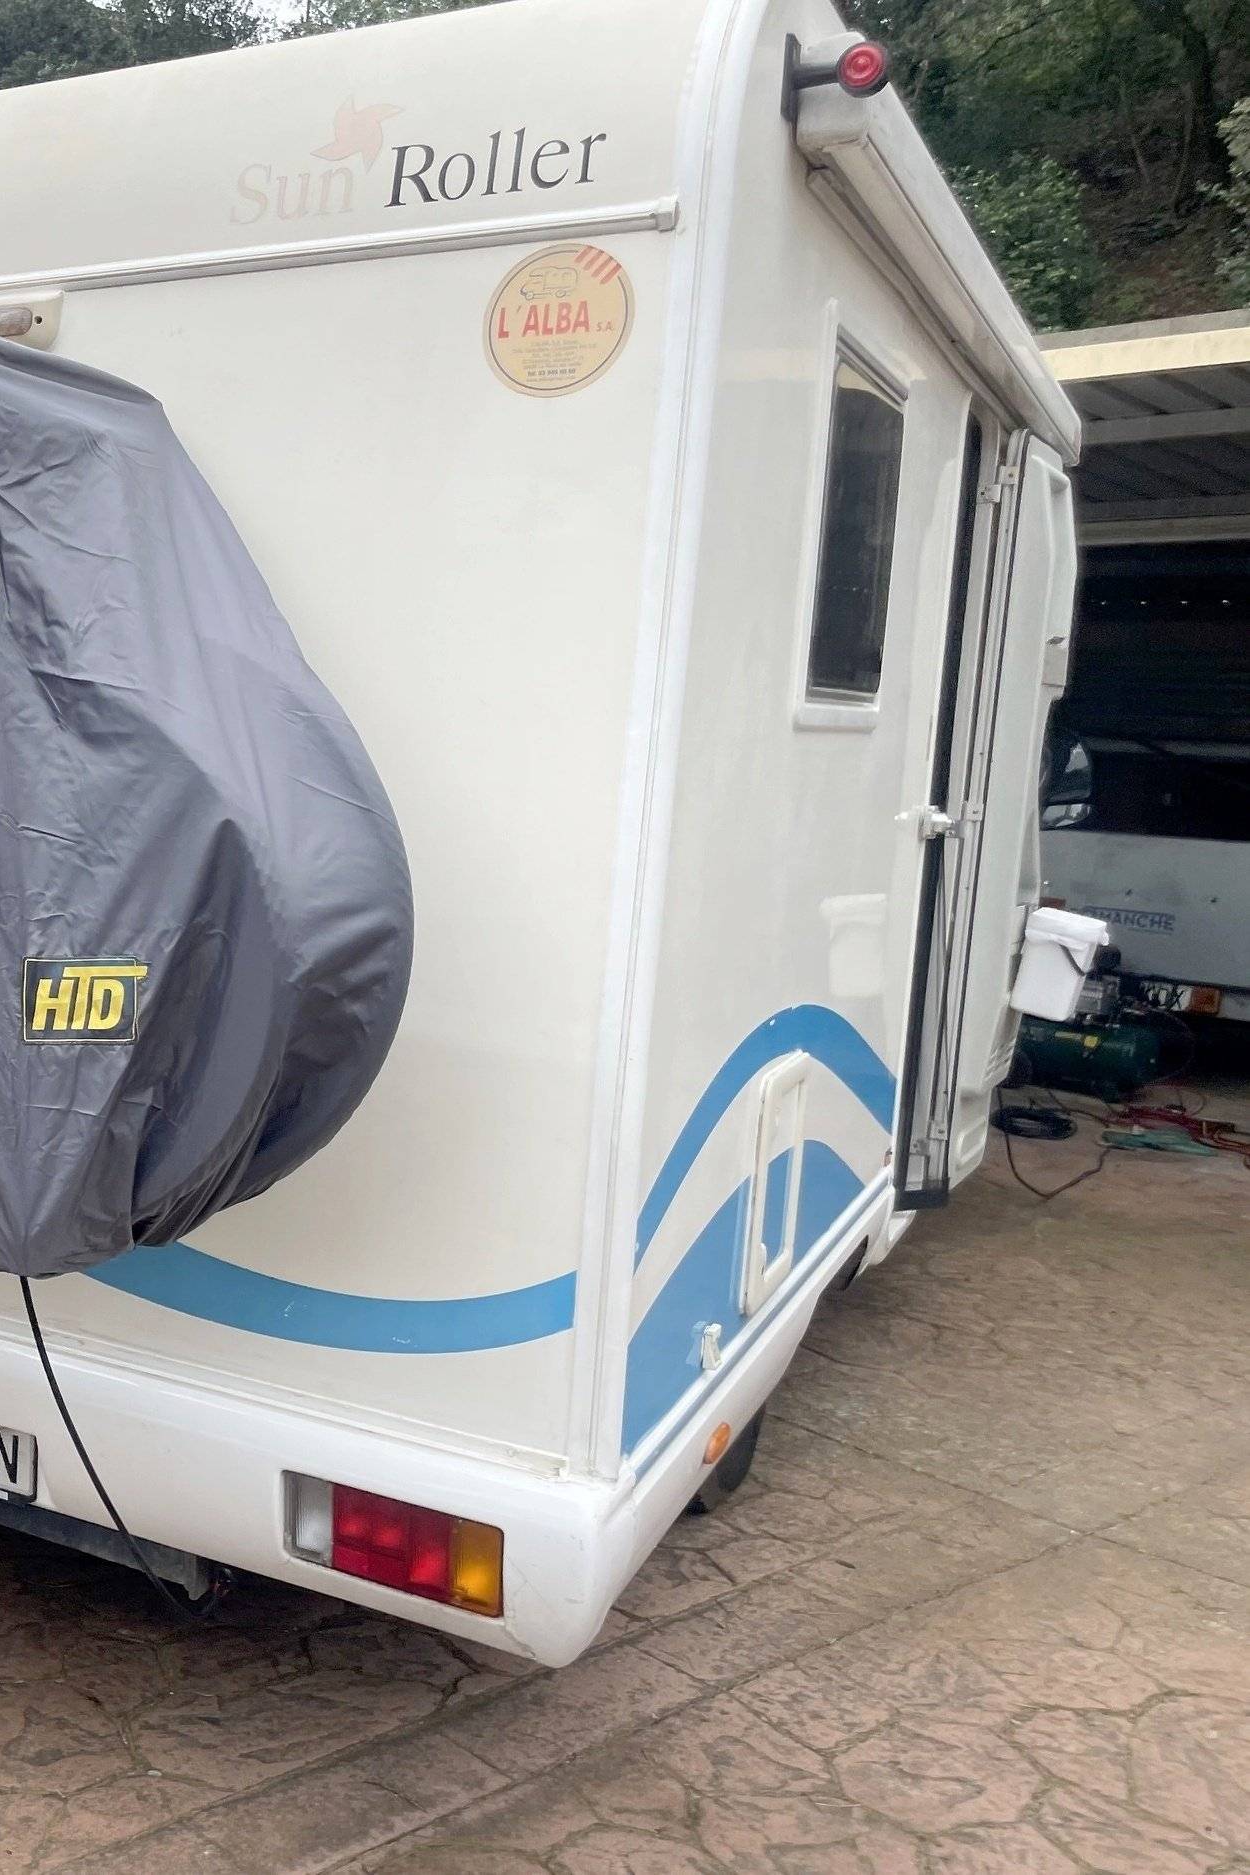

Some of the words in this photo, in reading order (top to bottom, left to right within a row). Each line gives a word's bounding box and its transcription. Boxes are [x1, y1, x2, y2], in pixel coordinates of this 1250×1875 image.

[229, 163, 355, 225] Sun
[383, 126, 607, 208] Roller
[31, 965, 148, 1031] HTD
